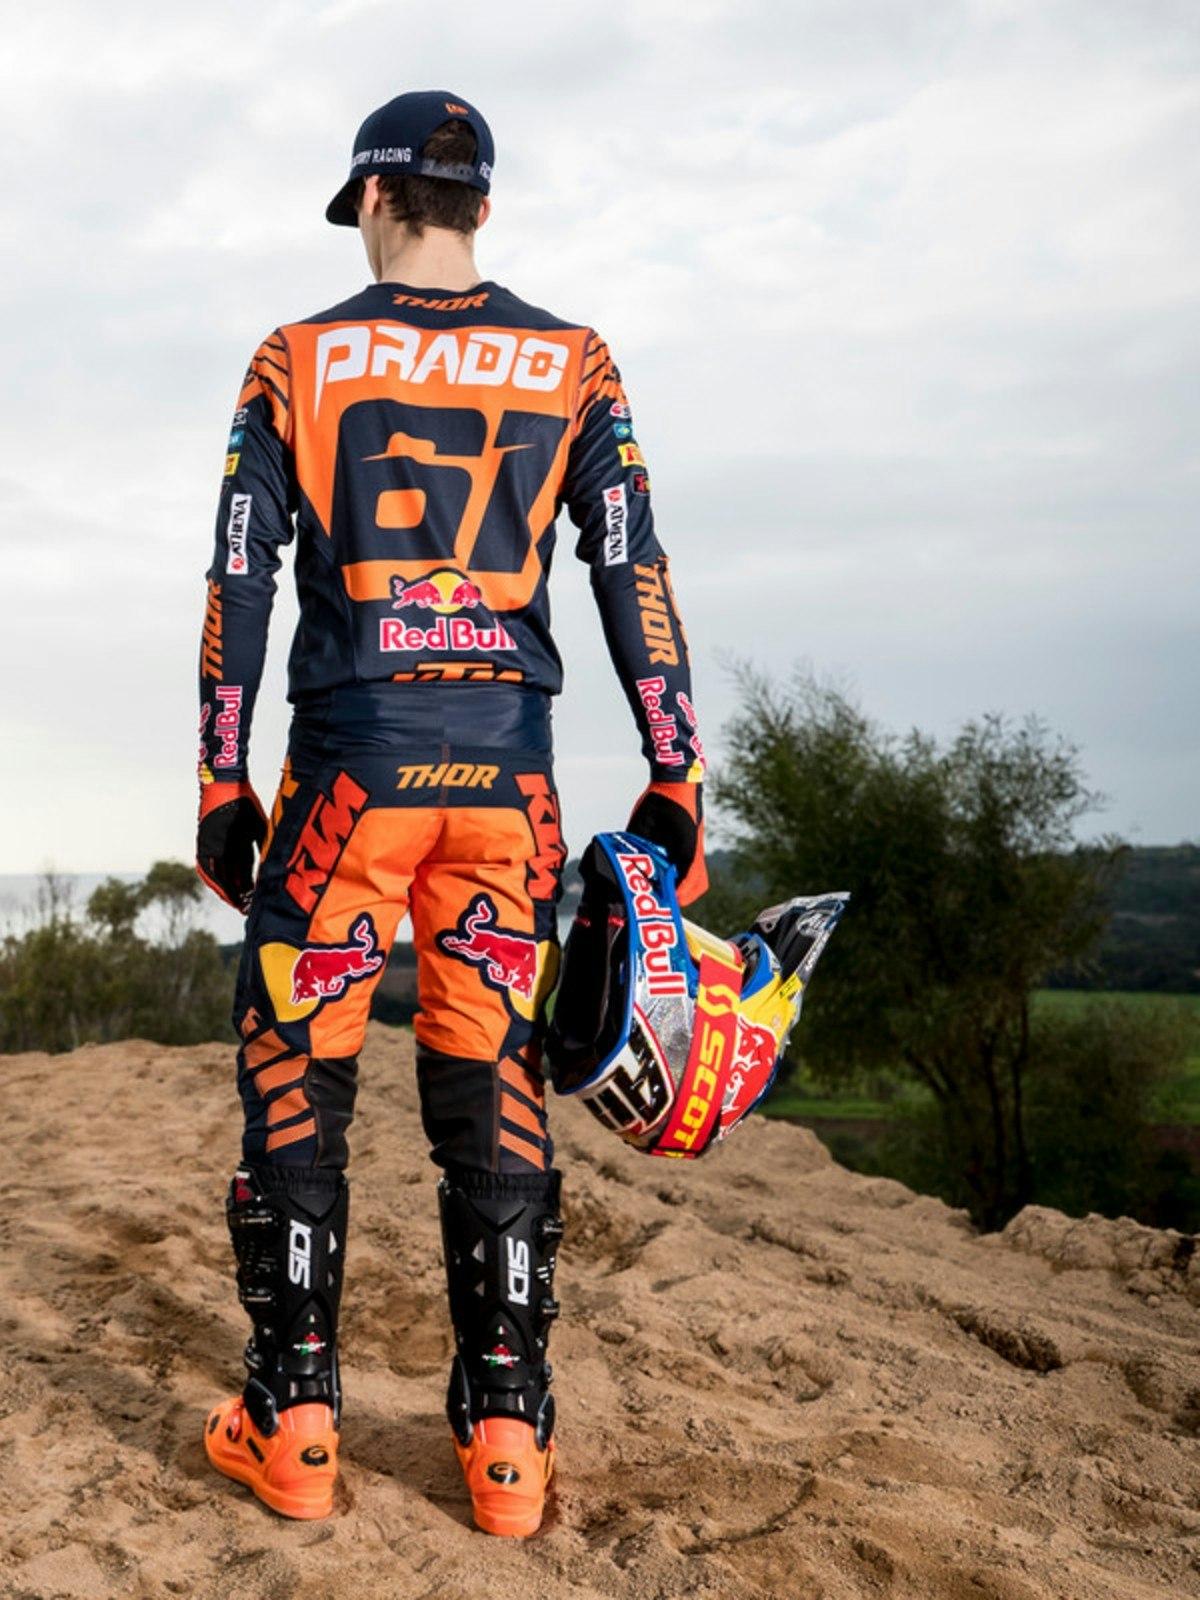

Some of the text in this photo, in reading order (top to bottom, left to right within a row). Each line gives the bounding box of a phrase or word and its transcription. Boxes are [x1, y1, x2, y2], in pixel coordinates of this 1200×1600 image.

[372, 147, 412, 163] RACING
[392, 292, 490, 312] THOR
[314, 325, 570, 423] PRADO
[230, 499, 248, 558] ATHENA
[331, 398, 570, 574] 61
[202, 578, 223, 681] THOR
[380, 617, 518, 652] Red Bull
[633, 564, 680, 667] THOR
[214, 685, 242, 768] Red Bull
[636, 676, 686, 767] Red Bull
[396, 763, 500, 789] THOR
[616, 853, 687, 997] Red Bull
[665, 1021, 726, 1158] SCOT
